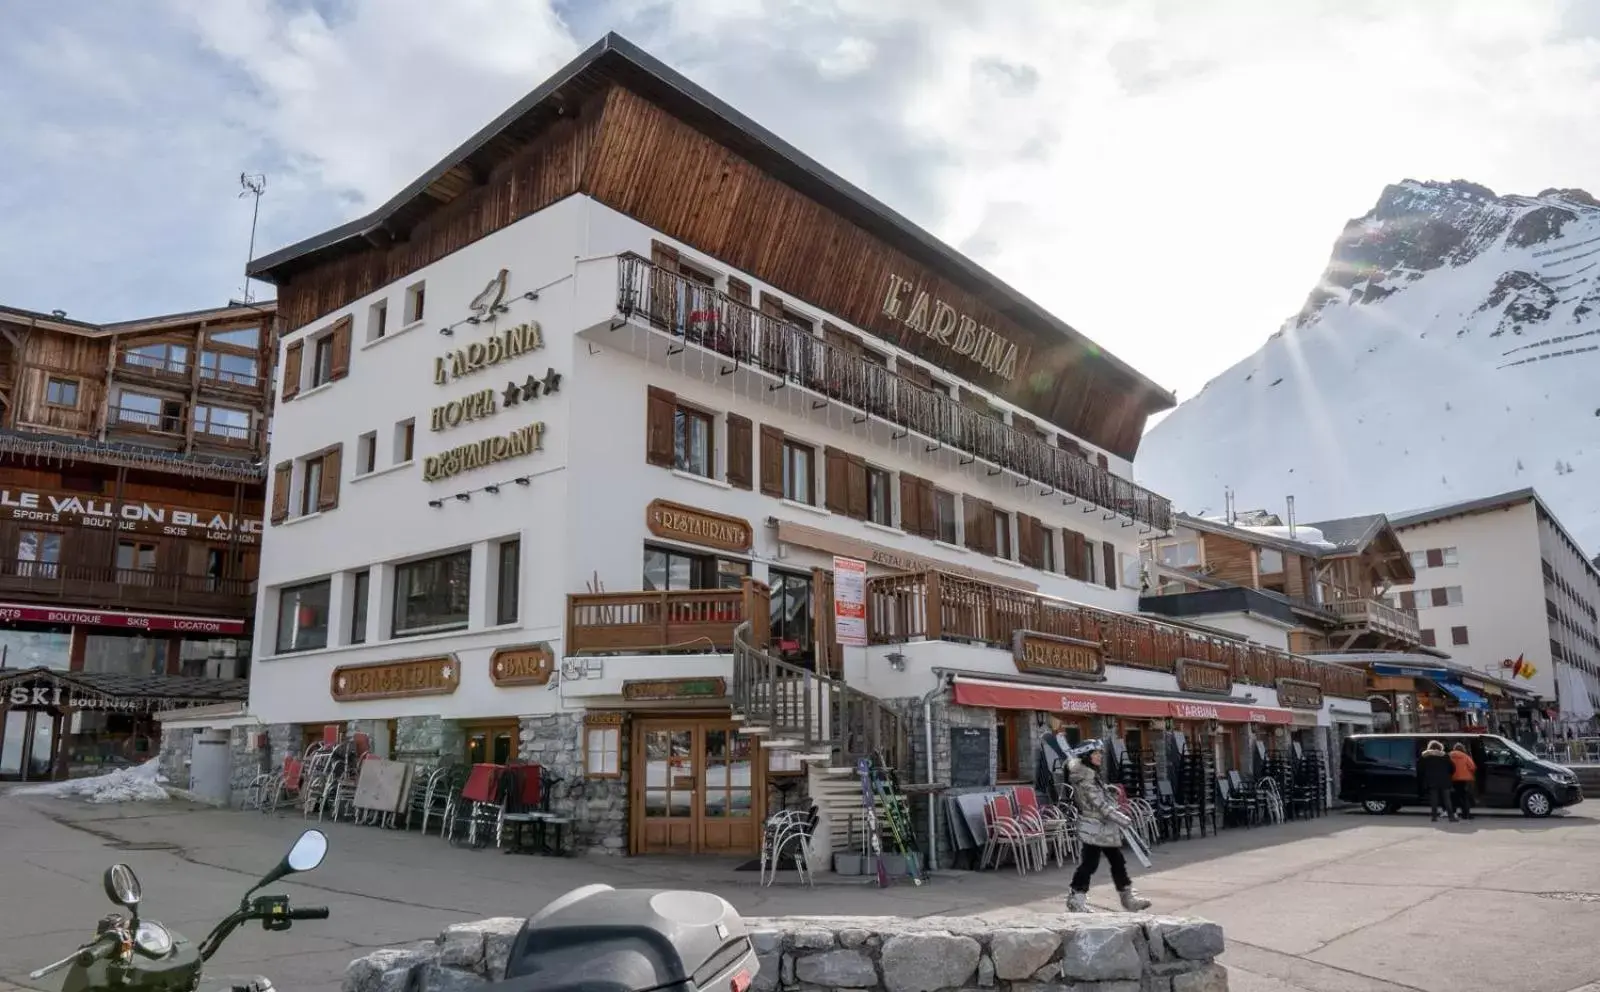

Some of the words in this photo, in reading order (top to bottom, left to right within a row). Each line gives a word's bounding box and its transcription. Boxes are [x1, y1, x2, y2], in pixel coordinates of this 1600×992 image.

[882, 273, 1017, 380] L'ARBINA
[430, 388, 496, 431] HOTEL
[422, 421, 545, 481] RESTAURANT
[1, 490, 39, 508] LE
[13, 509, 59, 522] SPORTS
[163, 525, 188, 536] SKIS
[662, 510, 741, 545] RESTAURANT
[48, 612, 101, 624] BOUTIQUE
[127, 617, 149, 627] SKIS
[174, 621, 220, 632] LOCATION
[505, 654, 538, 677] BAR
[10, 687, 62, 706] SKI
[1062, 696, 1098, 712] Brasserie
[1177, 704, 1218, 719] L'ARBINA
